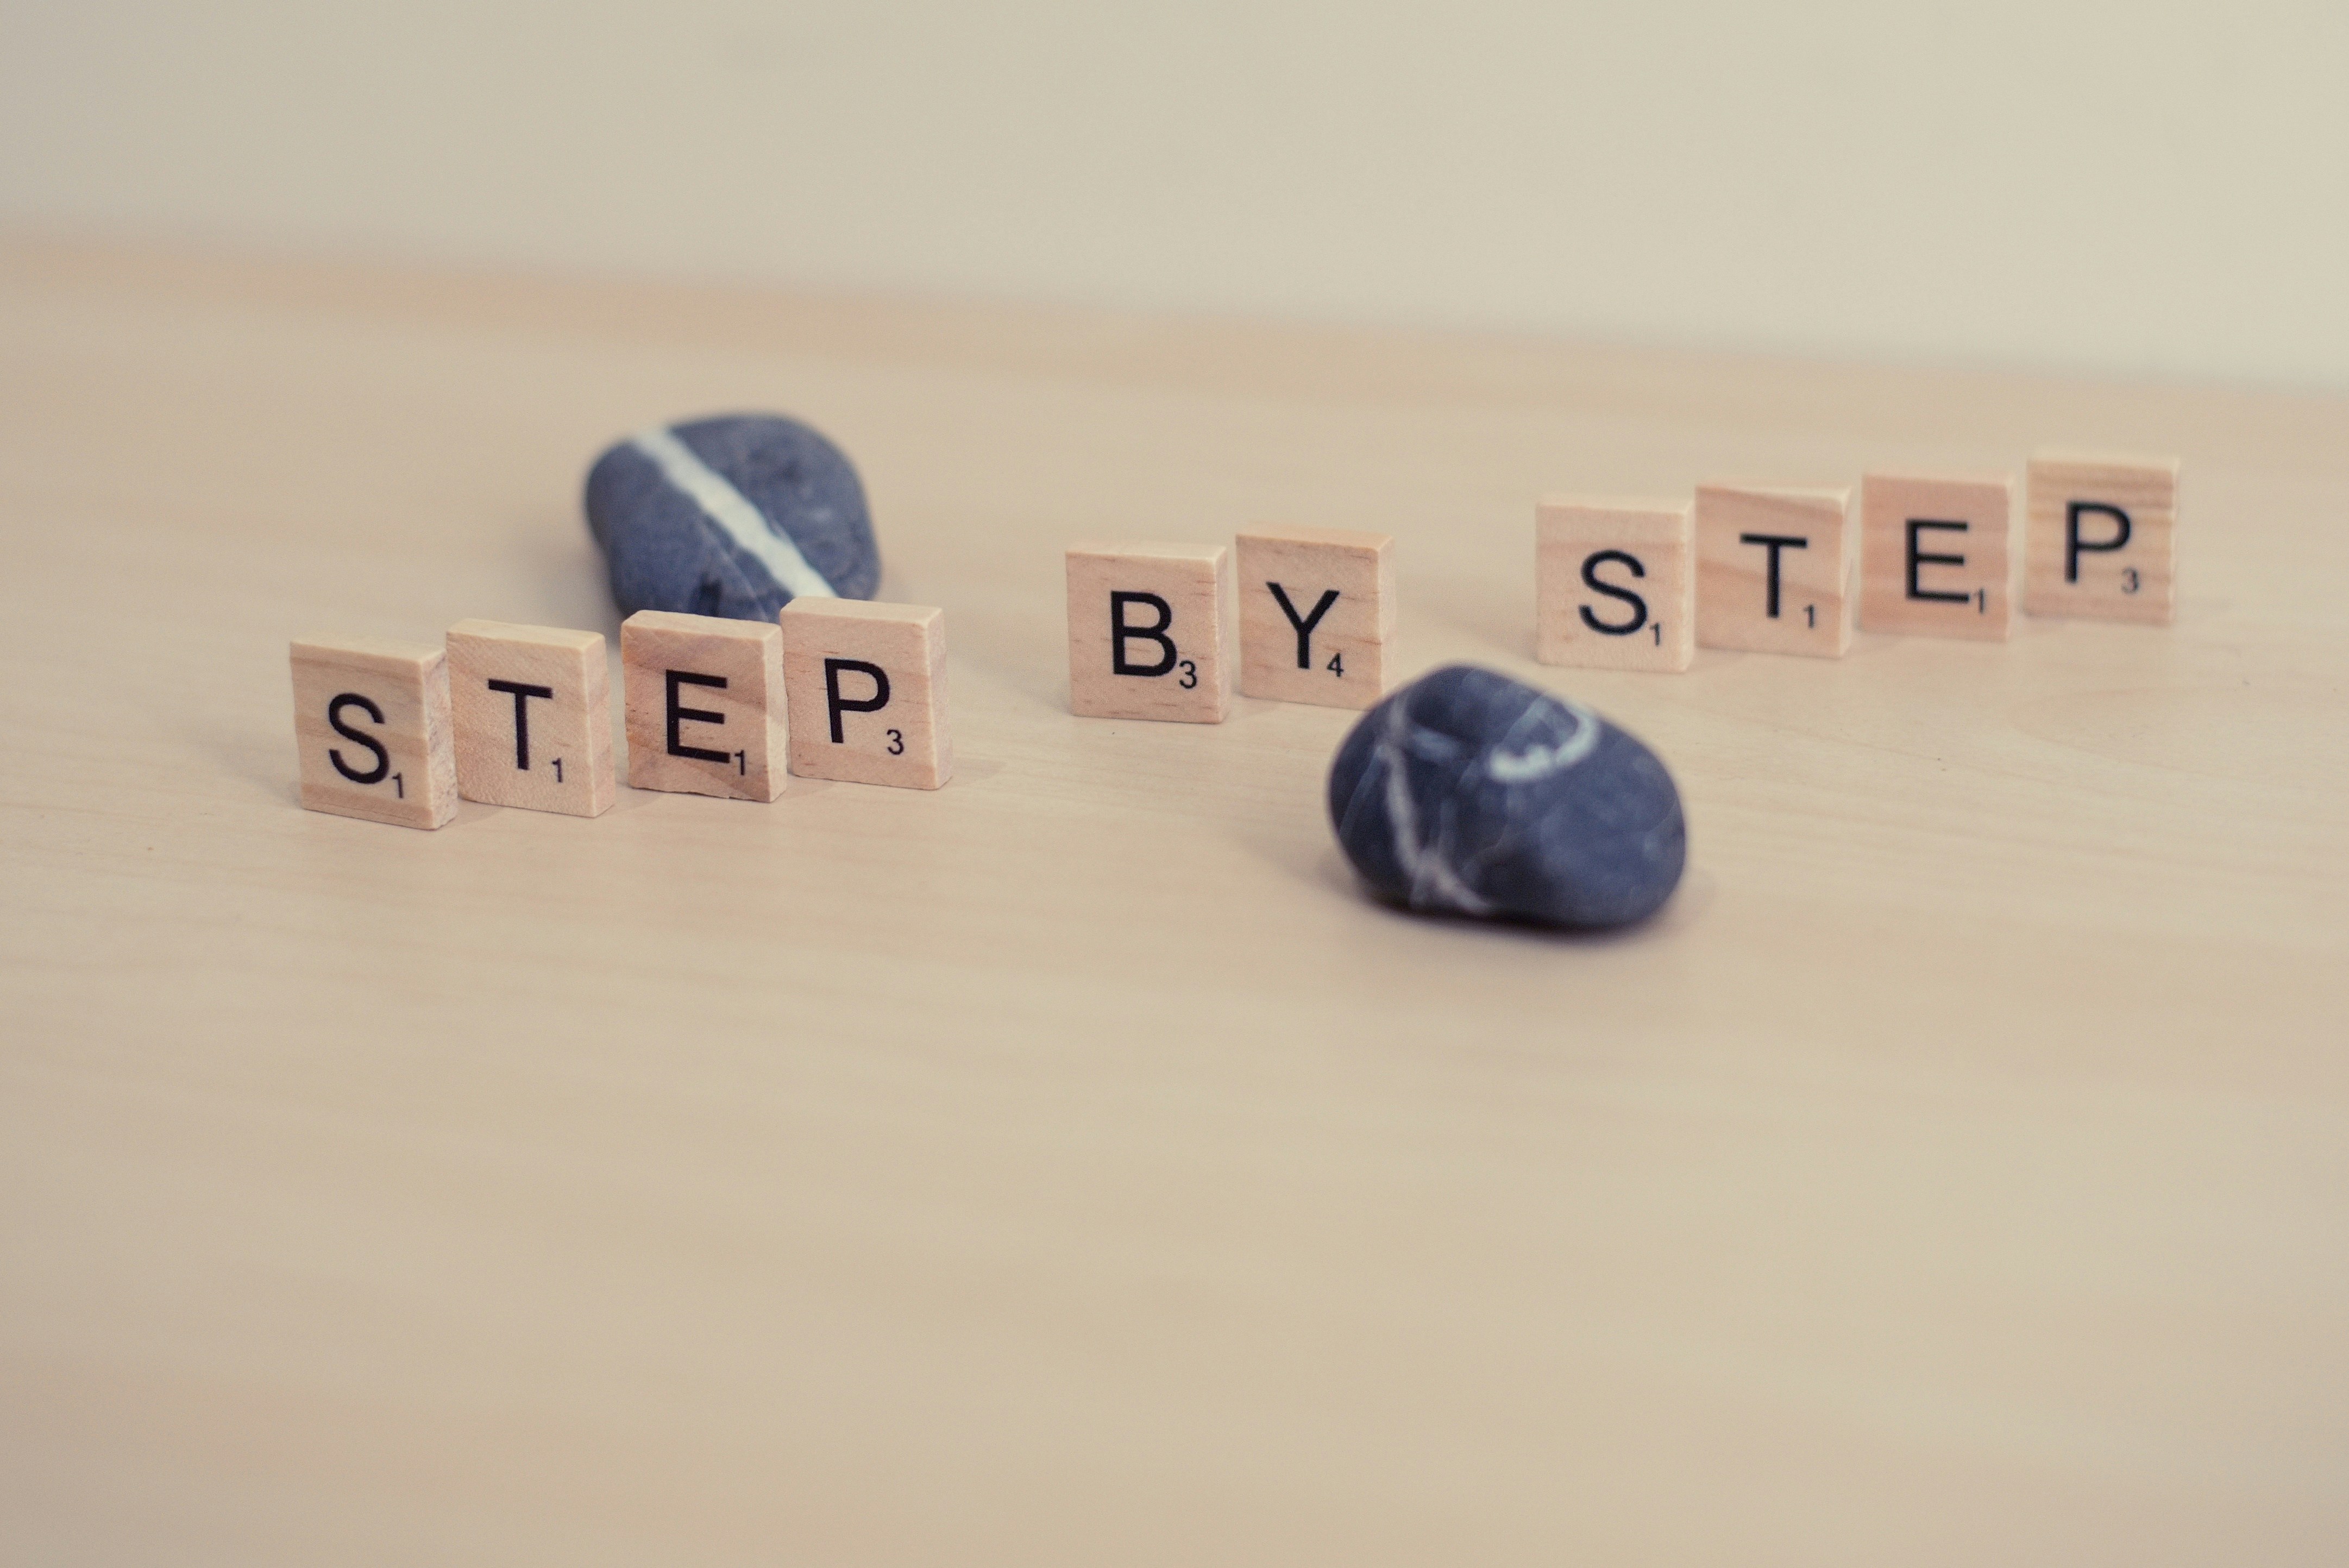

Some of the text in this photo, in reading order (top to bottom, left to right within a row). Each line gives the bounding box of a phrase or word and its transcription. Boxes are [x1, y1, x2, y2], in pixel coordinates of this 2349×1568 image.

[2122, 568, 2140, 593] 3
[1973, 589, 1986, 614] 1
[1804, 604, 1816, 629] 1
[1649, 622, 1660, 646] 1
[1178, 659, 1198, 690] 3
[1326, 652, 1345, 678] 4
[886, 728, 905, 756] 3
[551, 757, 563, 783] 1
[733, 749, 746, 777] 1
[391, 772, 405, 799] 1
